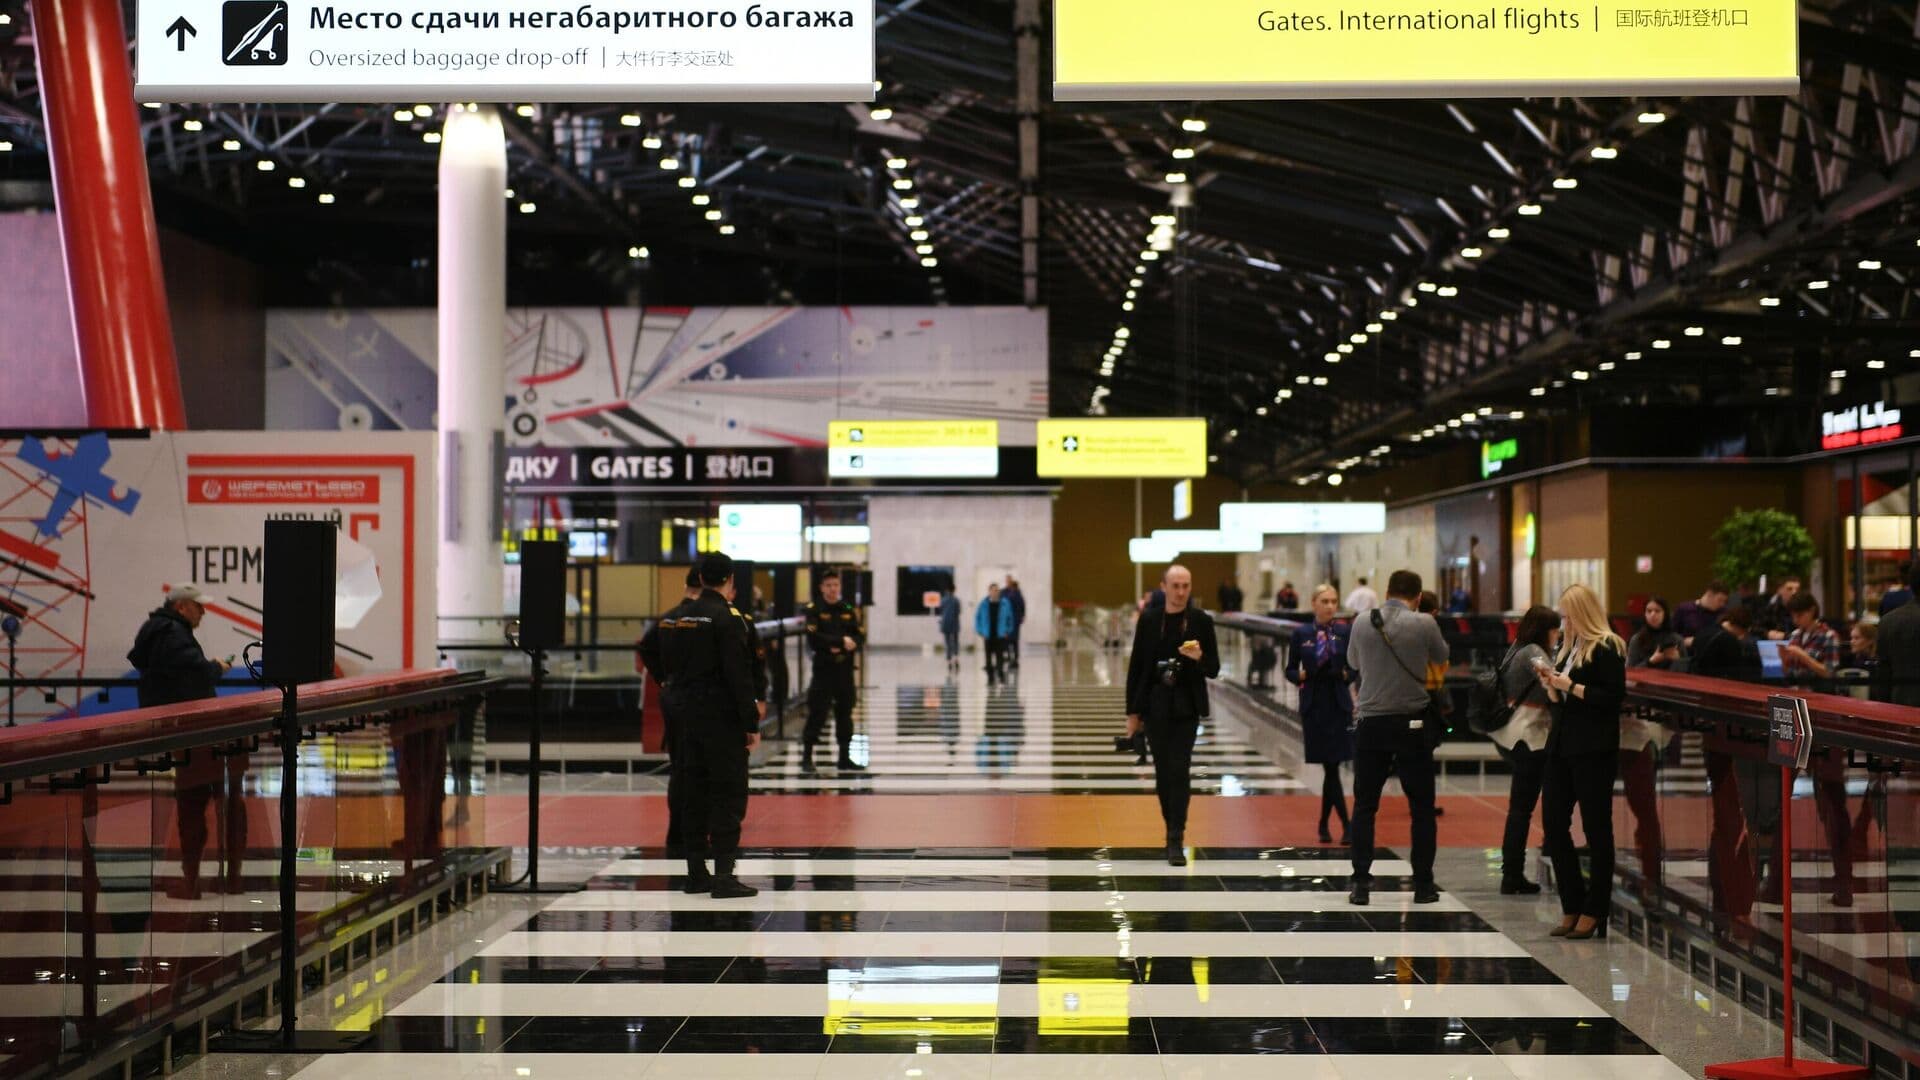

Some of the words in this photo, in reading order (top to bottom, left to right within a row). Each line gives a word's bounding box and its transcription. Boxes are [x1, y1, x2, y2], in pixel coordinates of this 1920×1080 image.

[310, 6, 403, 29] Место
[411, 11, 499, 33] сдачи
[509, 5, 737, 34] негабаритного
[746, 4, 854, 28] багажа
[1258, 10, 1332, 32] Gates.
[1340, 8, 1496, 31] International
[1503, 7, 1580, 35] flights
[1616, 9, 1748, 28] 国际航班登机口
[309, 48, 406, 67] Oversized
[413, 48, 500, 71] baggage
[506, 48, 589, 70] drop-off
[615, 50, 734, 67] 大件行李交运处
[591, 456, 673, 478] GATES
[705, 455, 773, 479] 登机口
